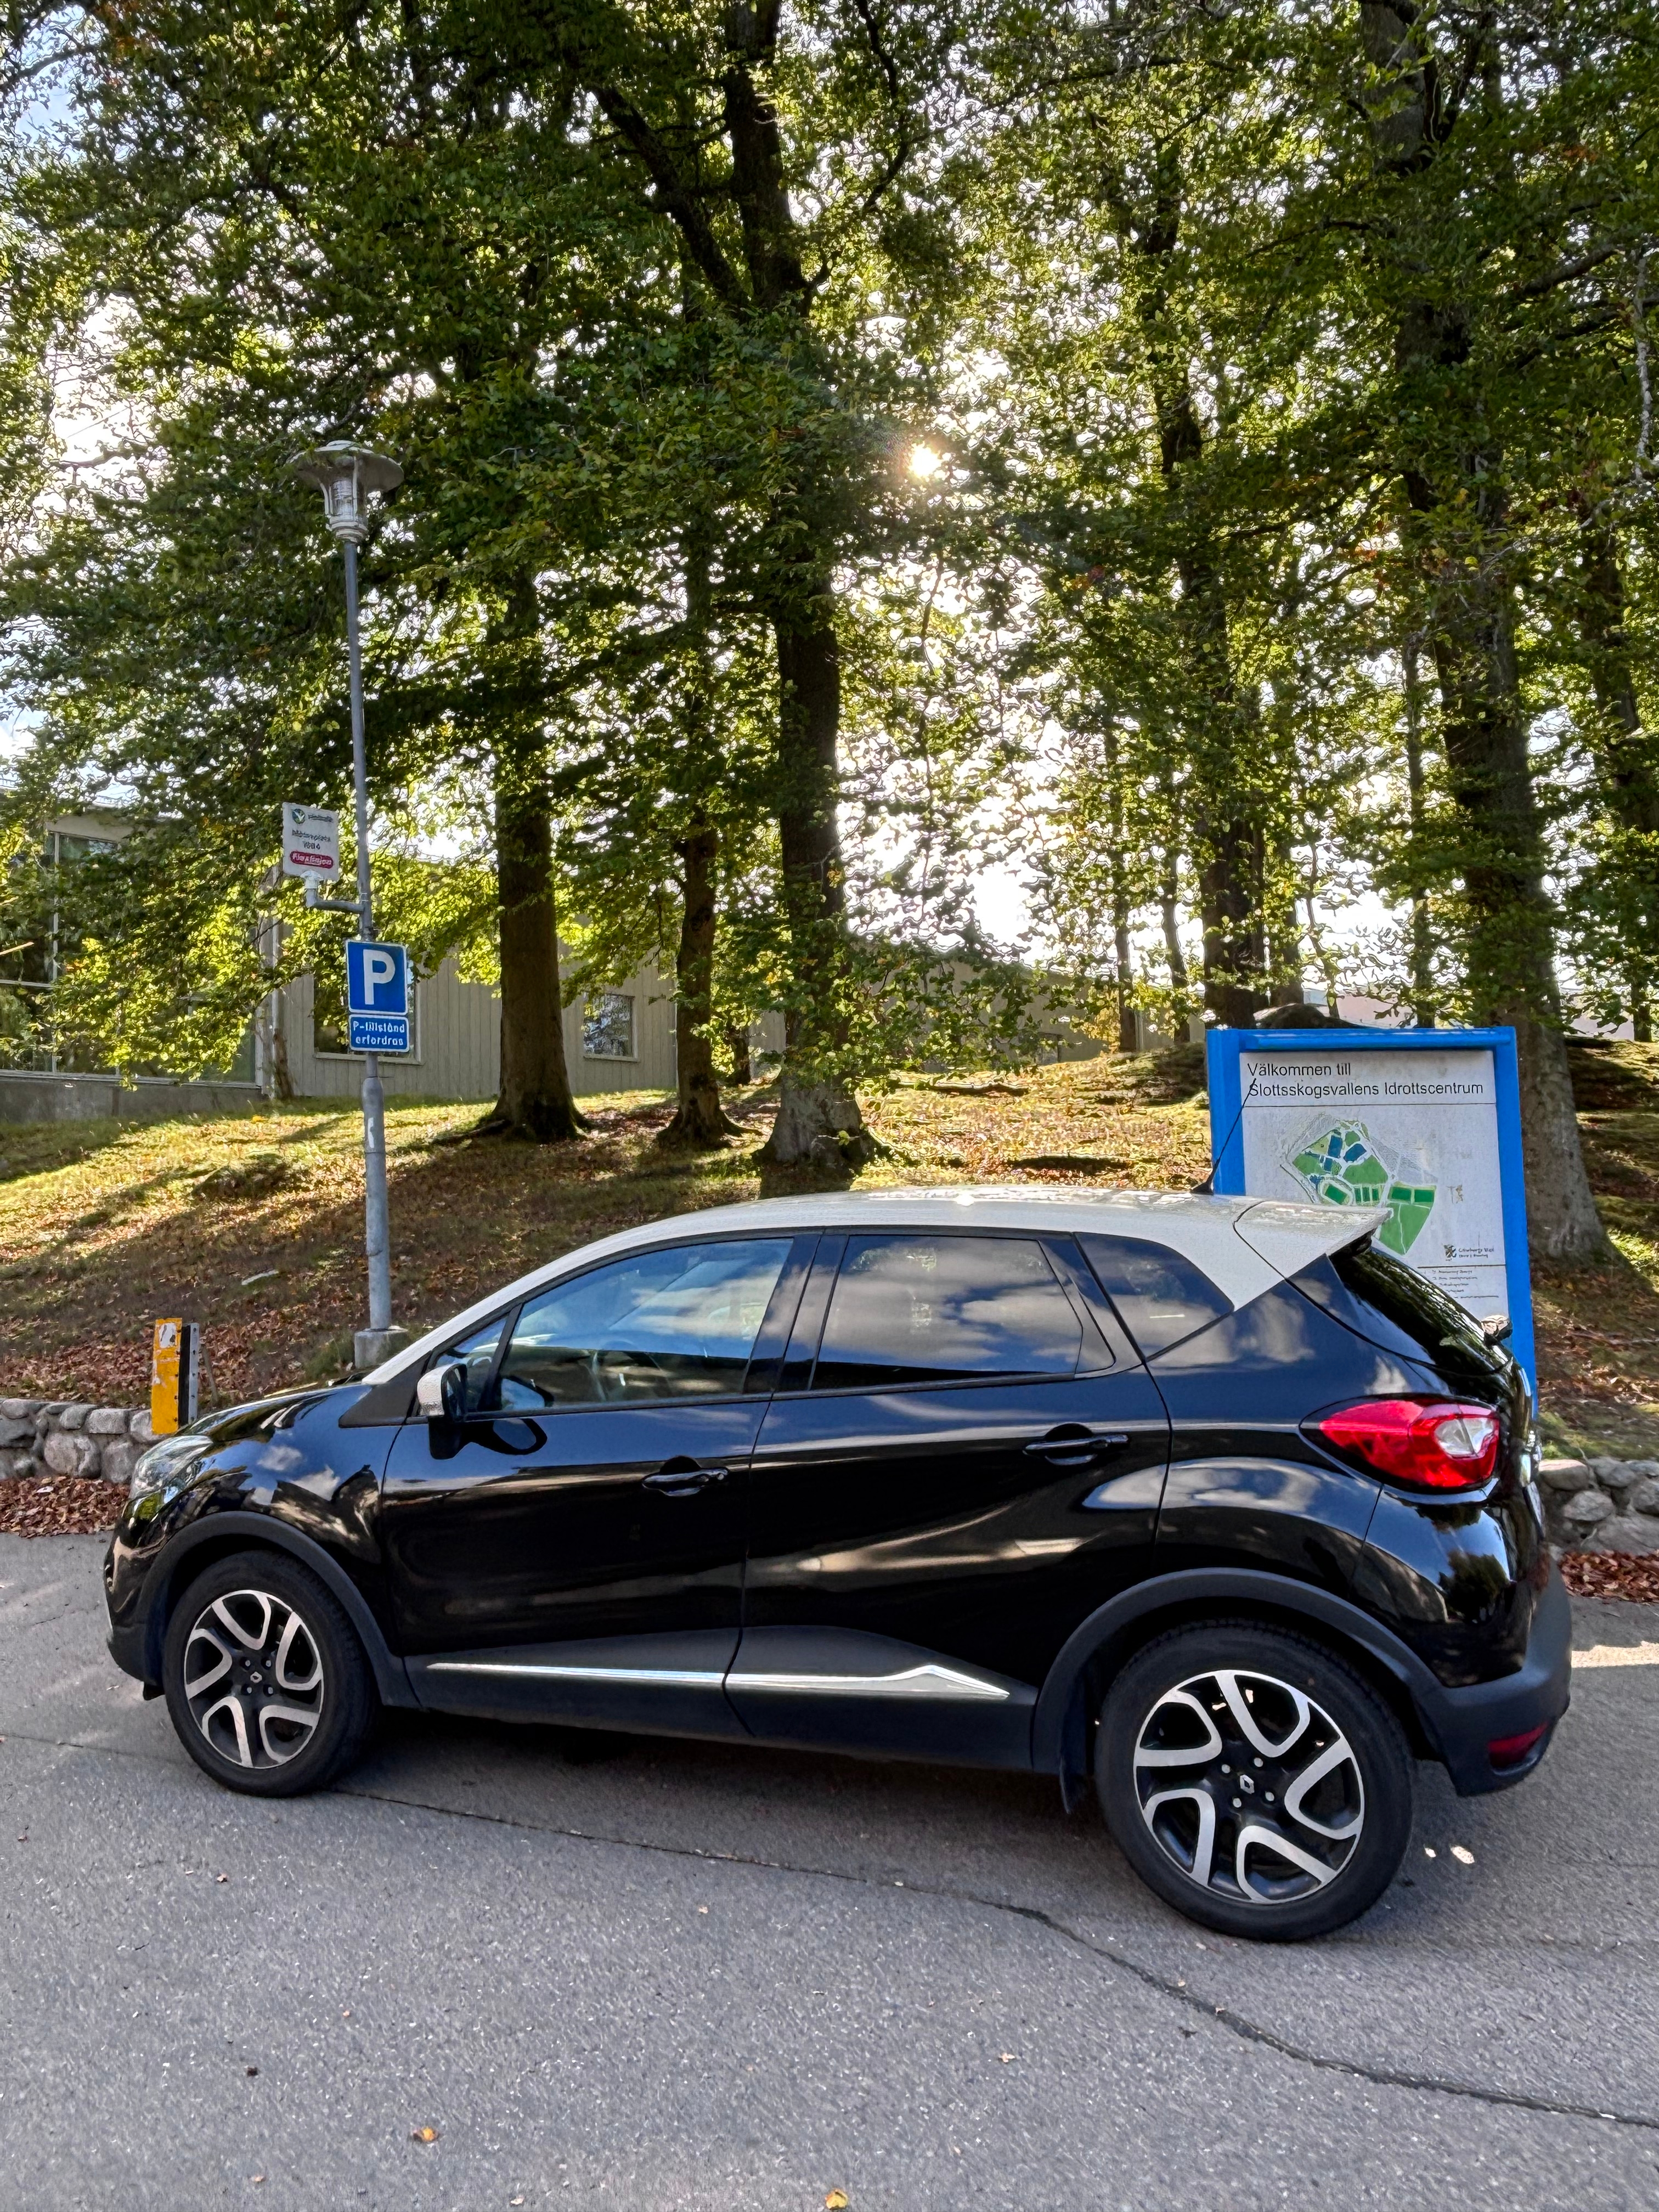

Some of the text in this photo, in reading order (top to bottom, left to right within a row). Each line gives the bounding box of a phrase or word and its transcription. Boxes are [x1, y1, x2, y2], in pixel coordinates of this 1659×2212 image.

[363, 949, 396, 1005] P
[356, 1034, 404, 1046] erfordras
[1247, 1062, 1351, 1076] Välkommen till
[1250, 1081, 1483, 1099] Slottsskogsvallens Idrottscentrum
